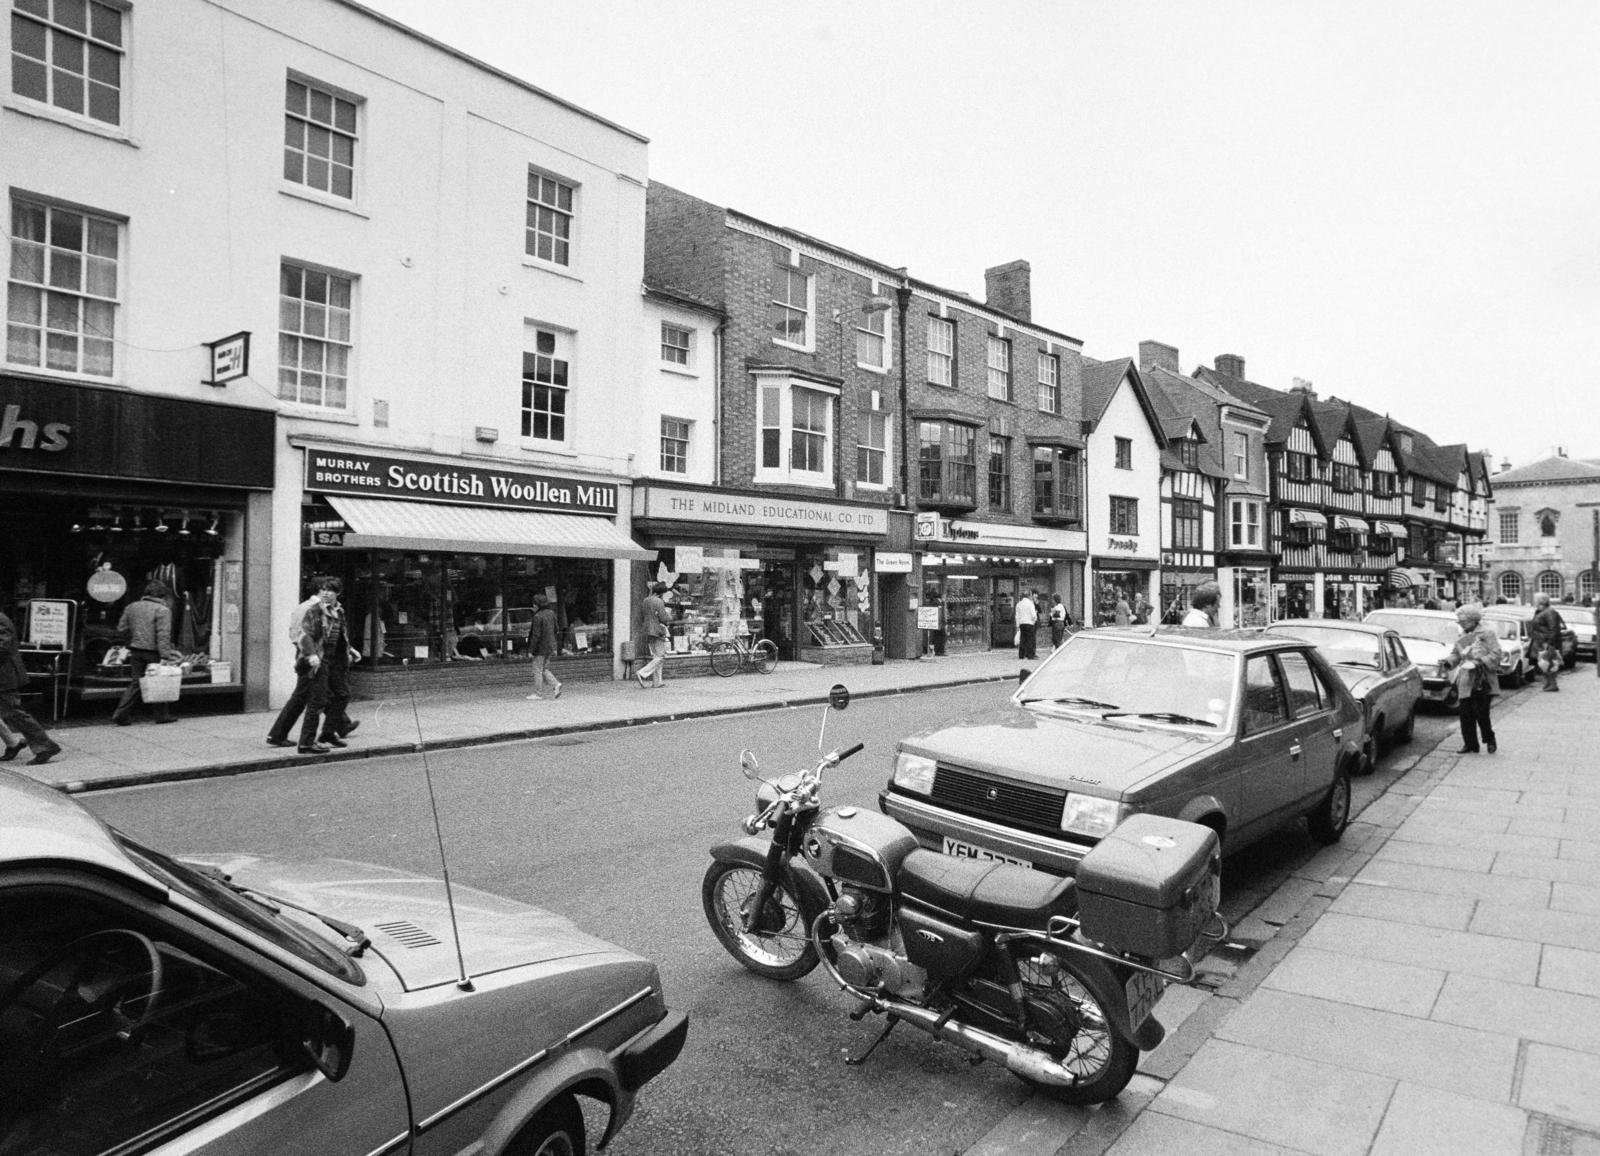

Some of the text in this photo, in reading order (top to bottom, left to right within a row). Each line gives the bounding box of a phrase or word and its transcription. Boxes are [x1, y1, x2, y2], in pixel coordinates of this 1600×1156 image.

[316, 457, 370, 471] MURRAY
[316, 472, 381, 487] BROTHERS
[387, 465, 615, 508] Scottish Woollen Mill
[670, 497, 694, 511] THE
[702, 500, 755, 516] MIDLAND
[762, 505, 834, 523] EDUCATIONAL
[858, 513, 874, 525] LTD
[1348, 574, 1378, 583] CHEATLE
